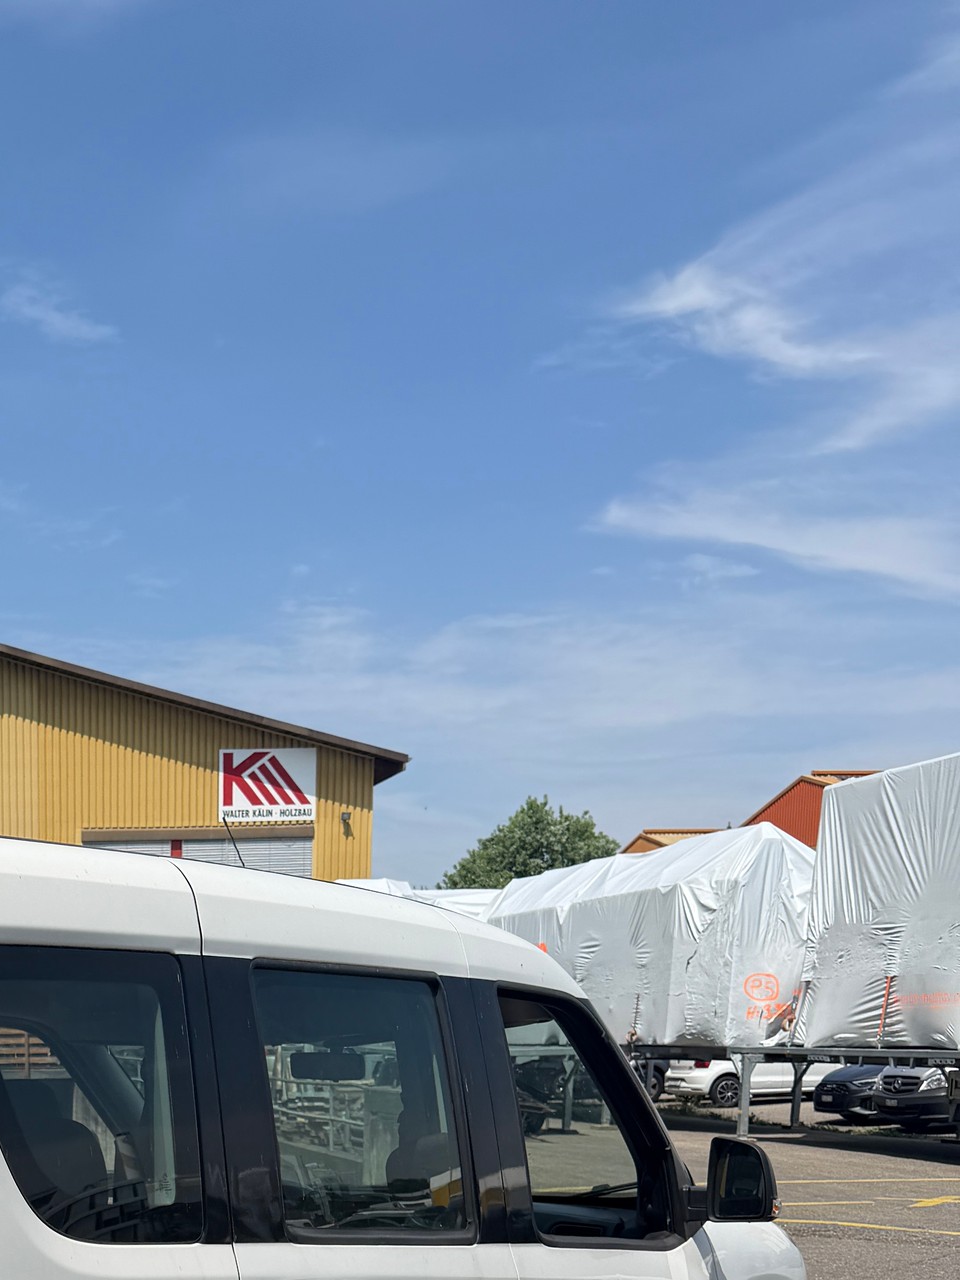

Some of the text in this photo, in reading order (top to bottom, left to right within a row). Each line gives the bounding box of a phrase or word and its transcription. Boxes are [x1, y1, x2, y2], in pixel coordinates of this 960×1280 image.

[222, 808, 312, 819] WALTER KÄLIN HOLZBAU
